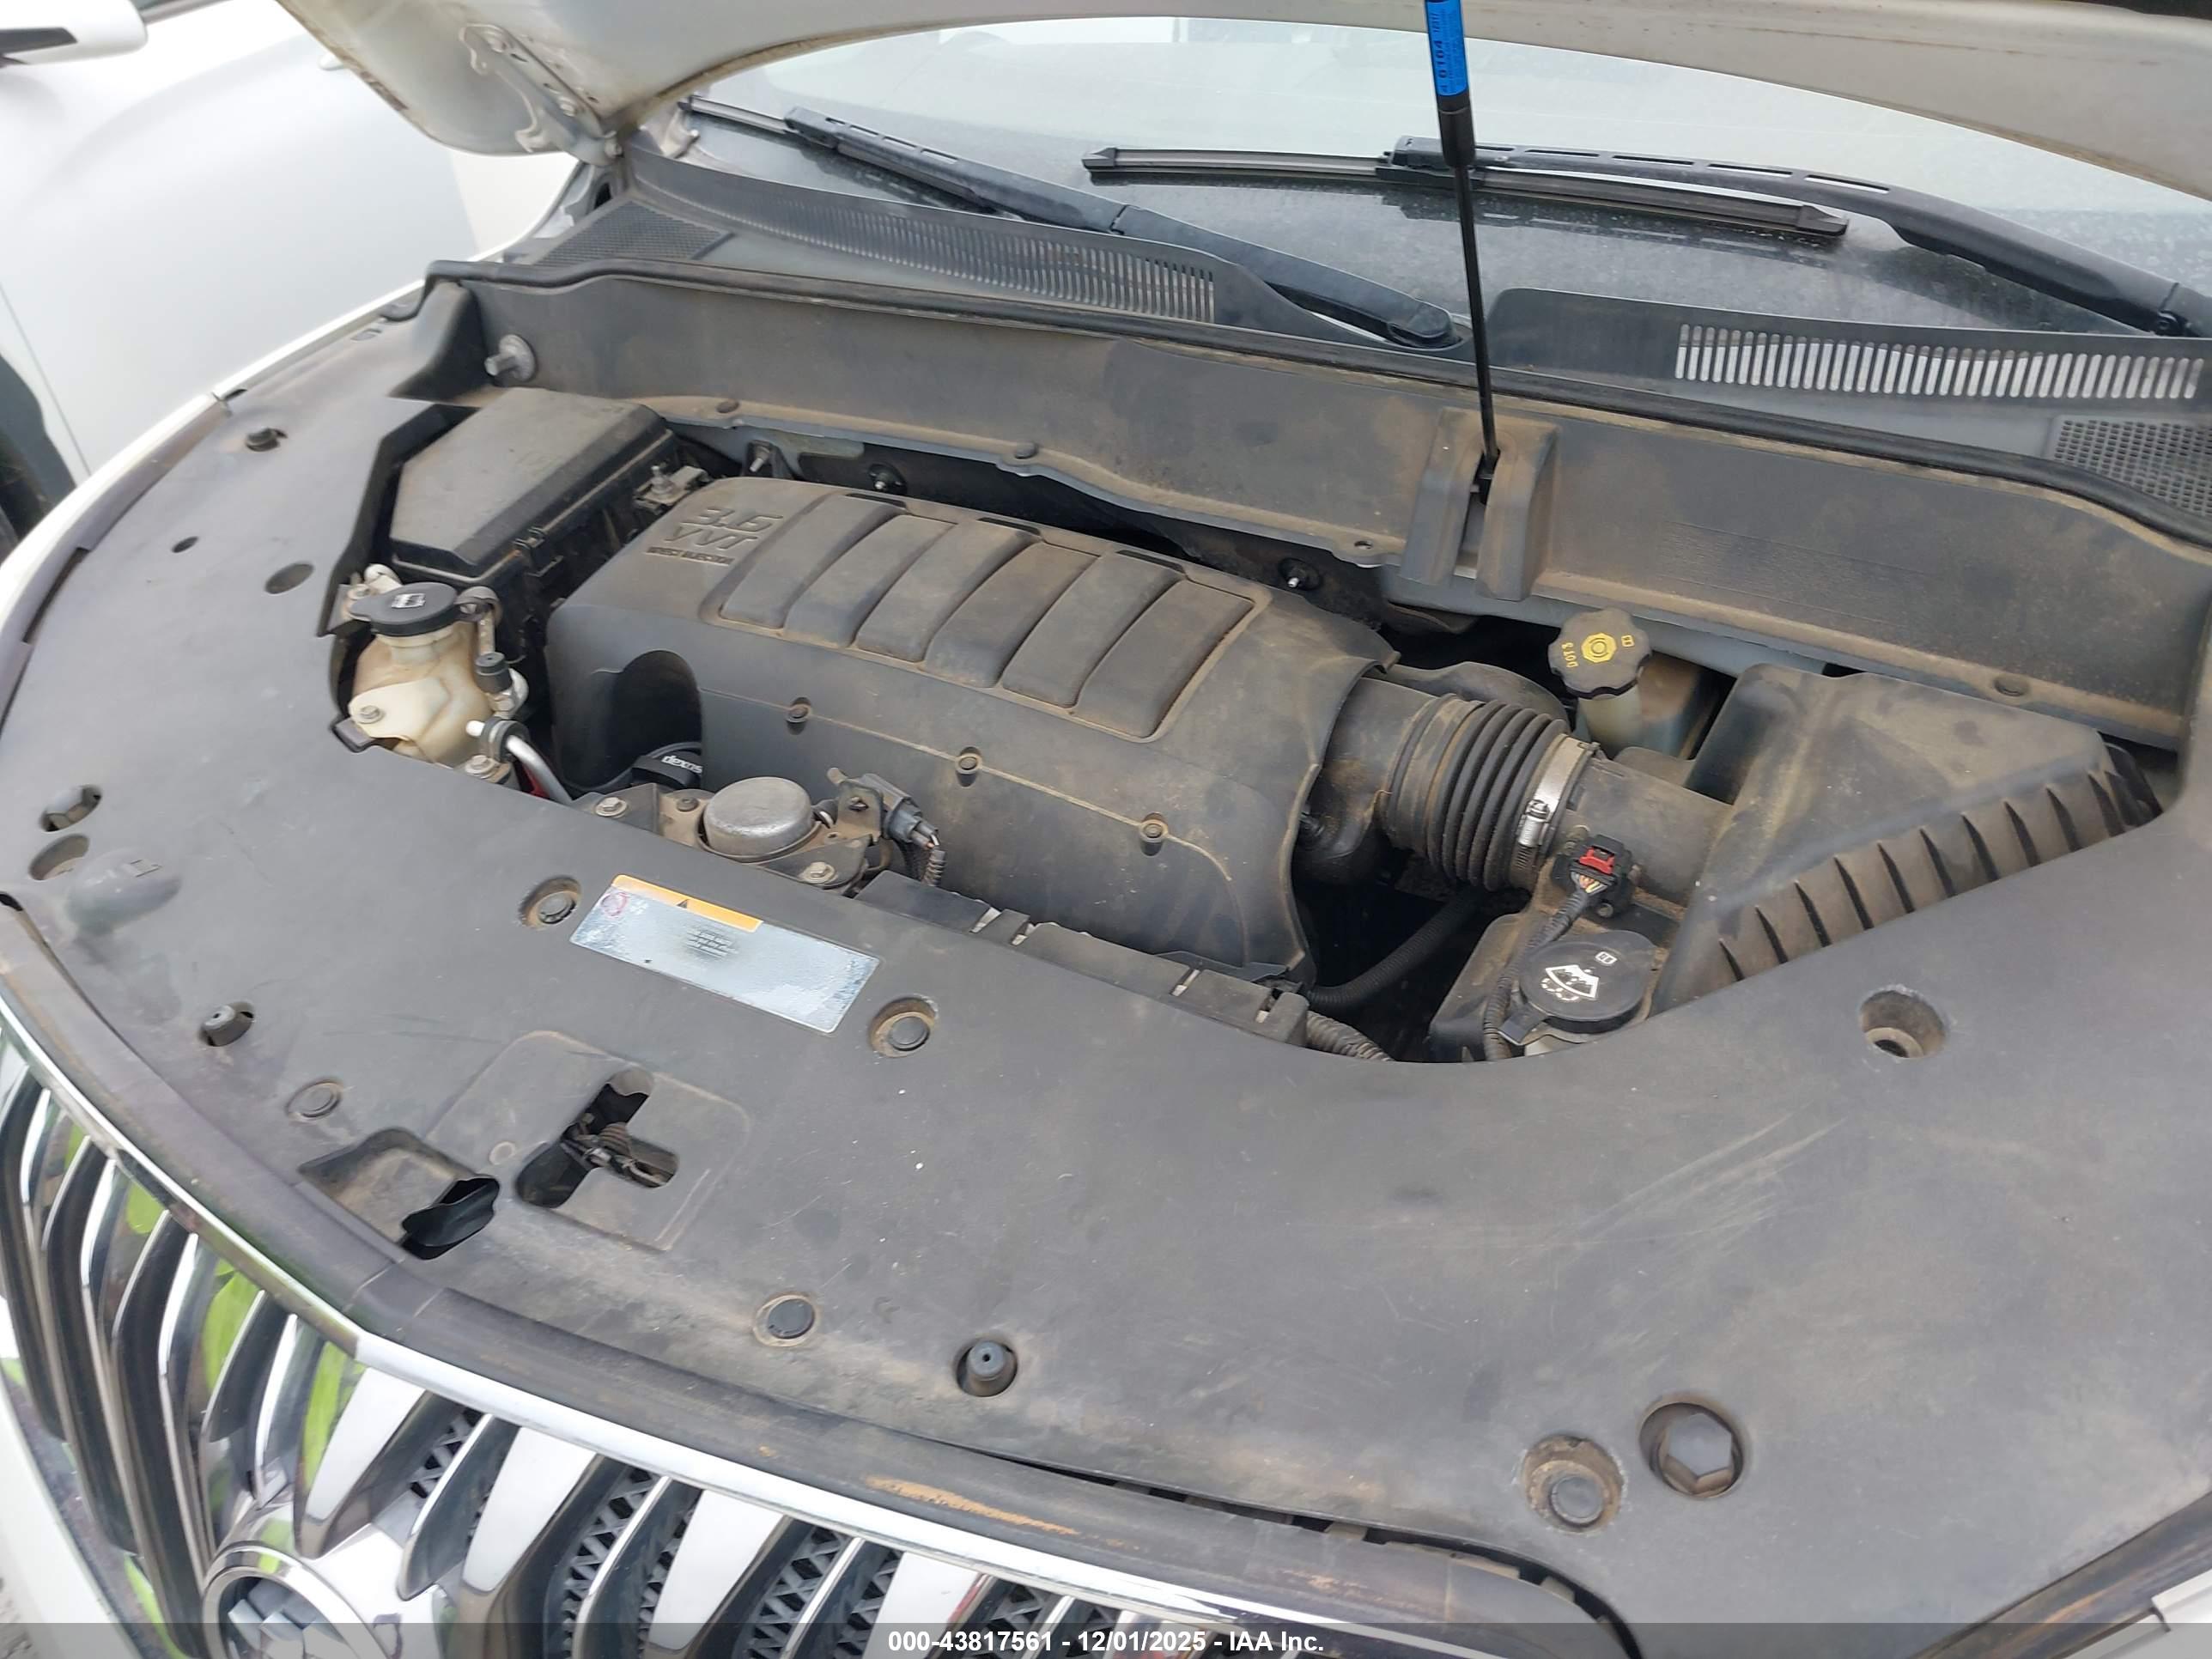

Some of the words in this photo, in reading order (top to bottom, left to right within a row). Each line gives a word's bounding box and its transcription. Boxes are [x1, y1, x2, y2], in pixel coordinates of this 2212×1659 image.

[681, 507, 784, 534] 3.6
[663, 526, 758, 551] VVT
[661, 756, 703, 773] dexos
